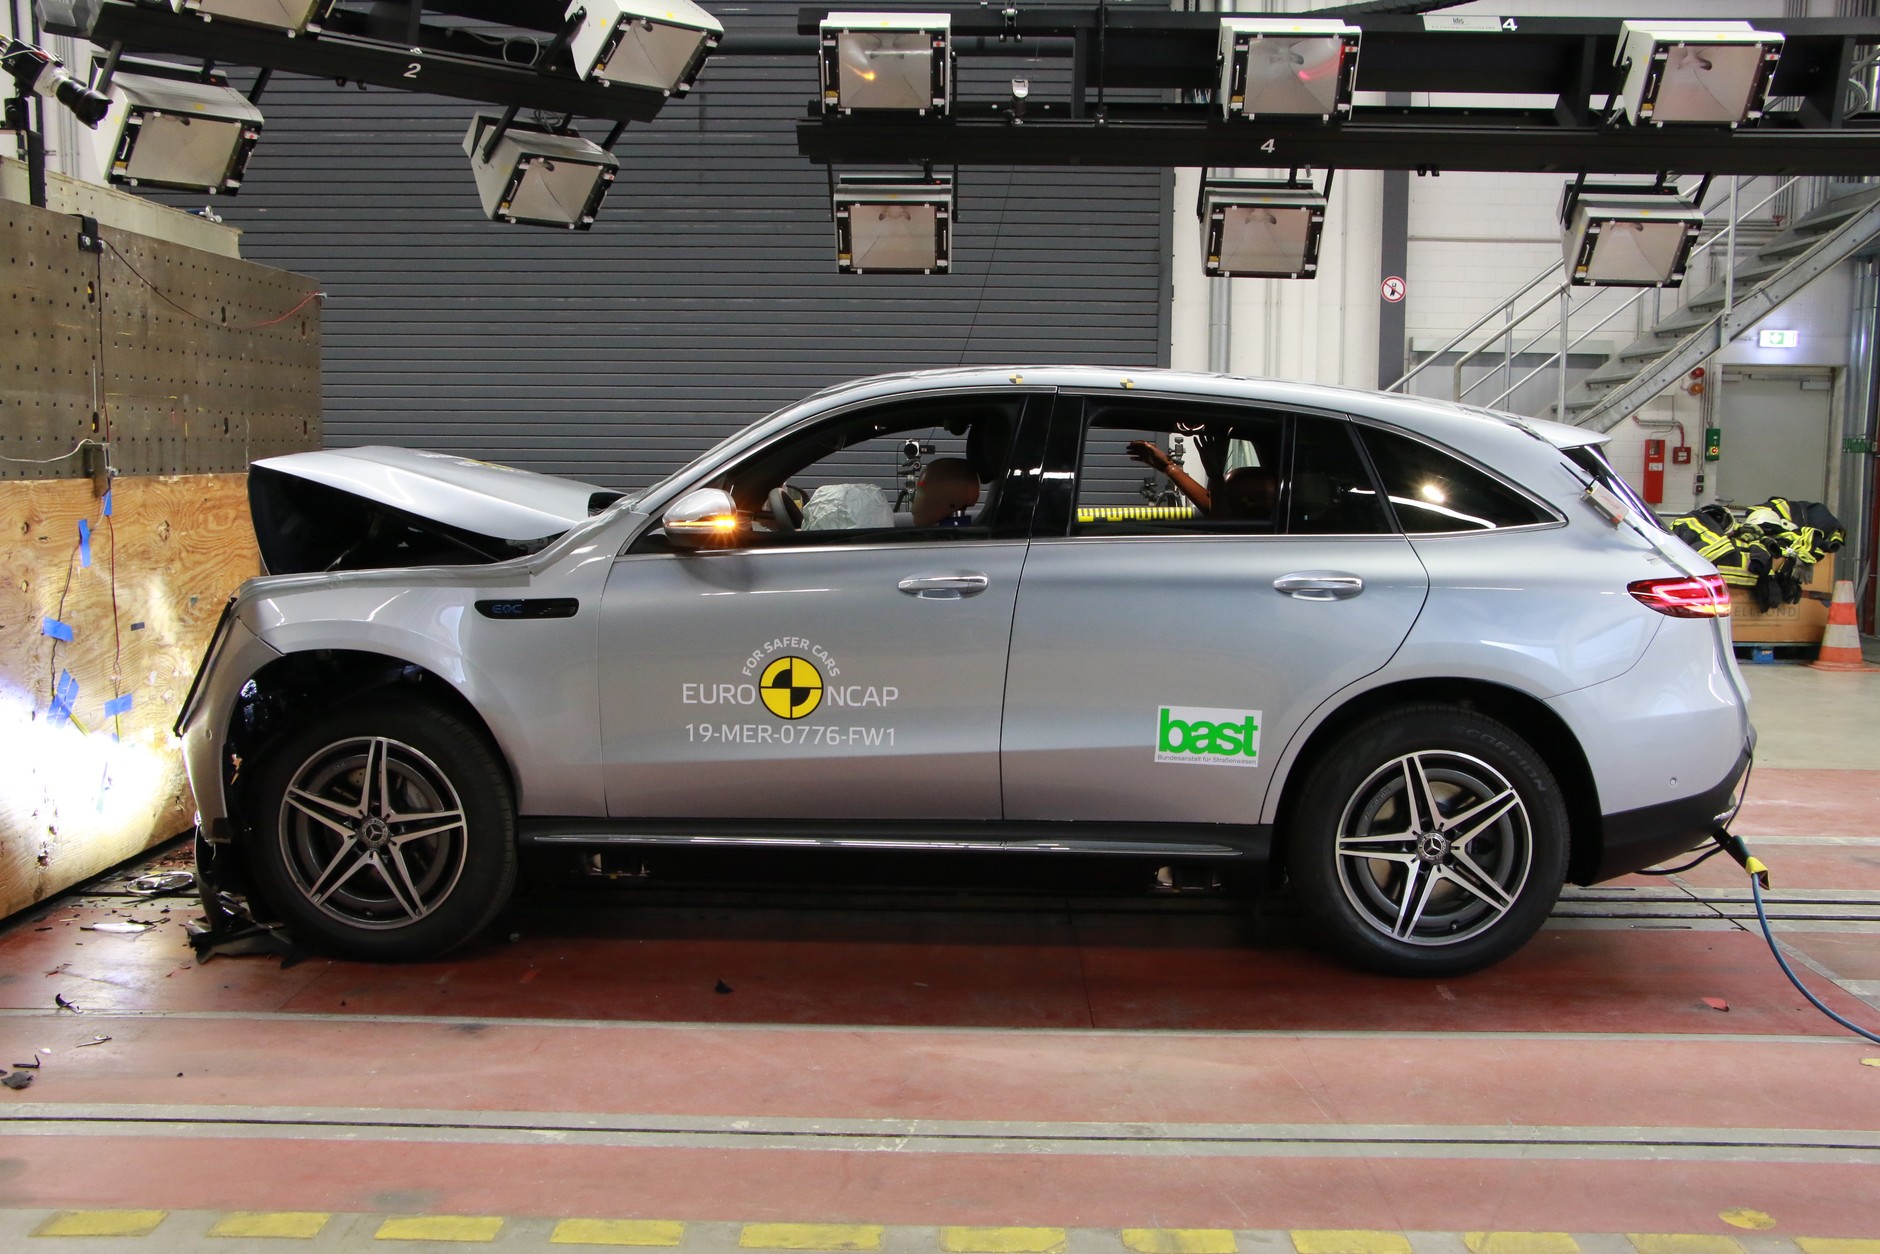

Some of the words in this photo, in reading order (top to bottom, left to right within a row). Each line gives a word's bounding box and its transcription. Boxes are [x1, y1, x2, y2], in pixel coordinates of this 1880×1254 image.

[1502, 18, 1518, 31] 4
[403, 63, 422, 79] 2
[1260, 138, 1276, 154] 4
[491, 604, 523, 614] EQC
[742, 648, 765, 677] FOR
[763, 636, 810, 654] SAFER
[811, 645, 841, 678] CARS
[682, 683, 756, 706] EURO
[827, 685, 899, 707] NCAP
[685, 723, 896, 747] 19-MER-0776-FW1
[1158, 708, 1259, 758] bast
[1157, 754, 1202, 763] Bundesanstalt
